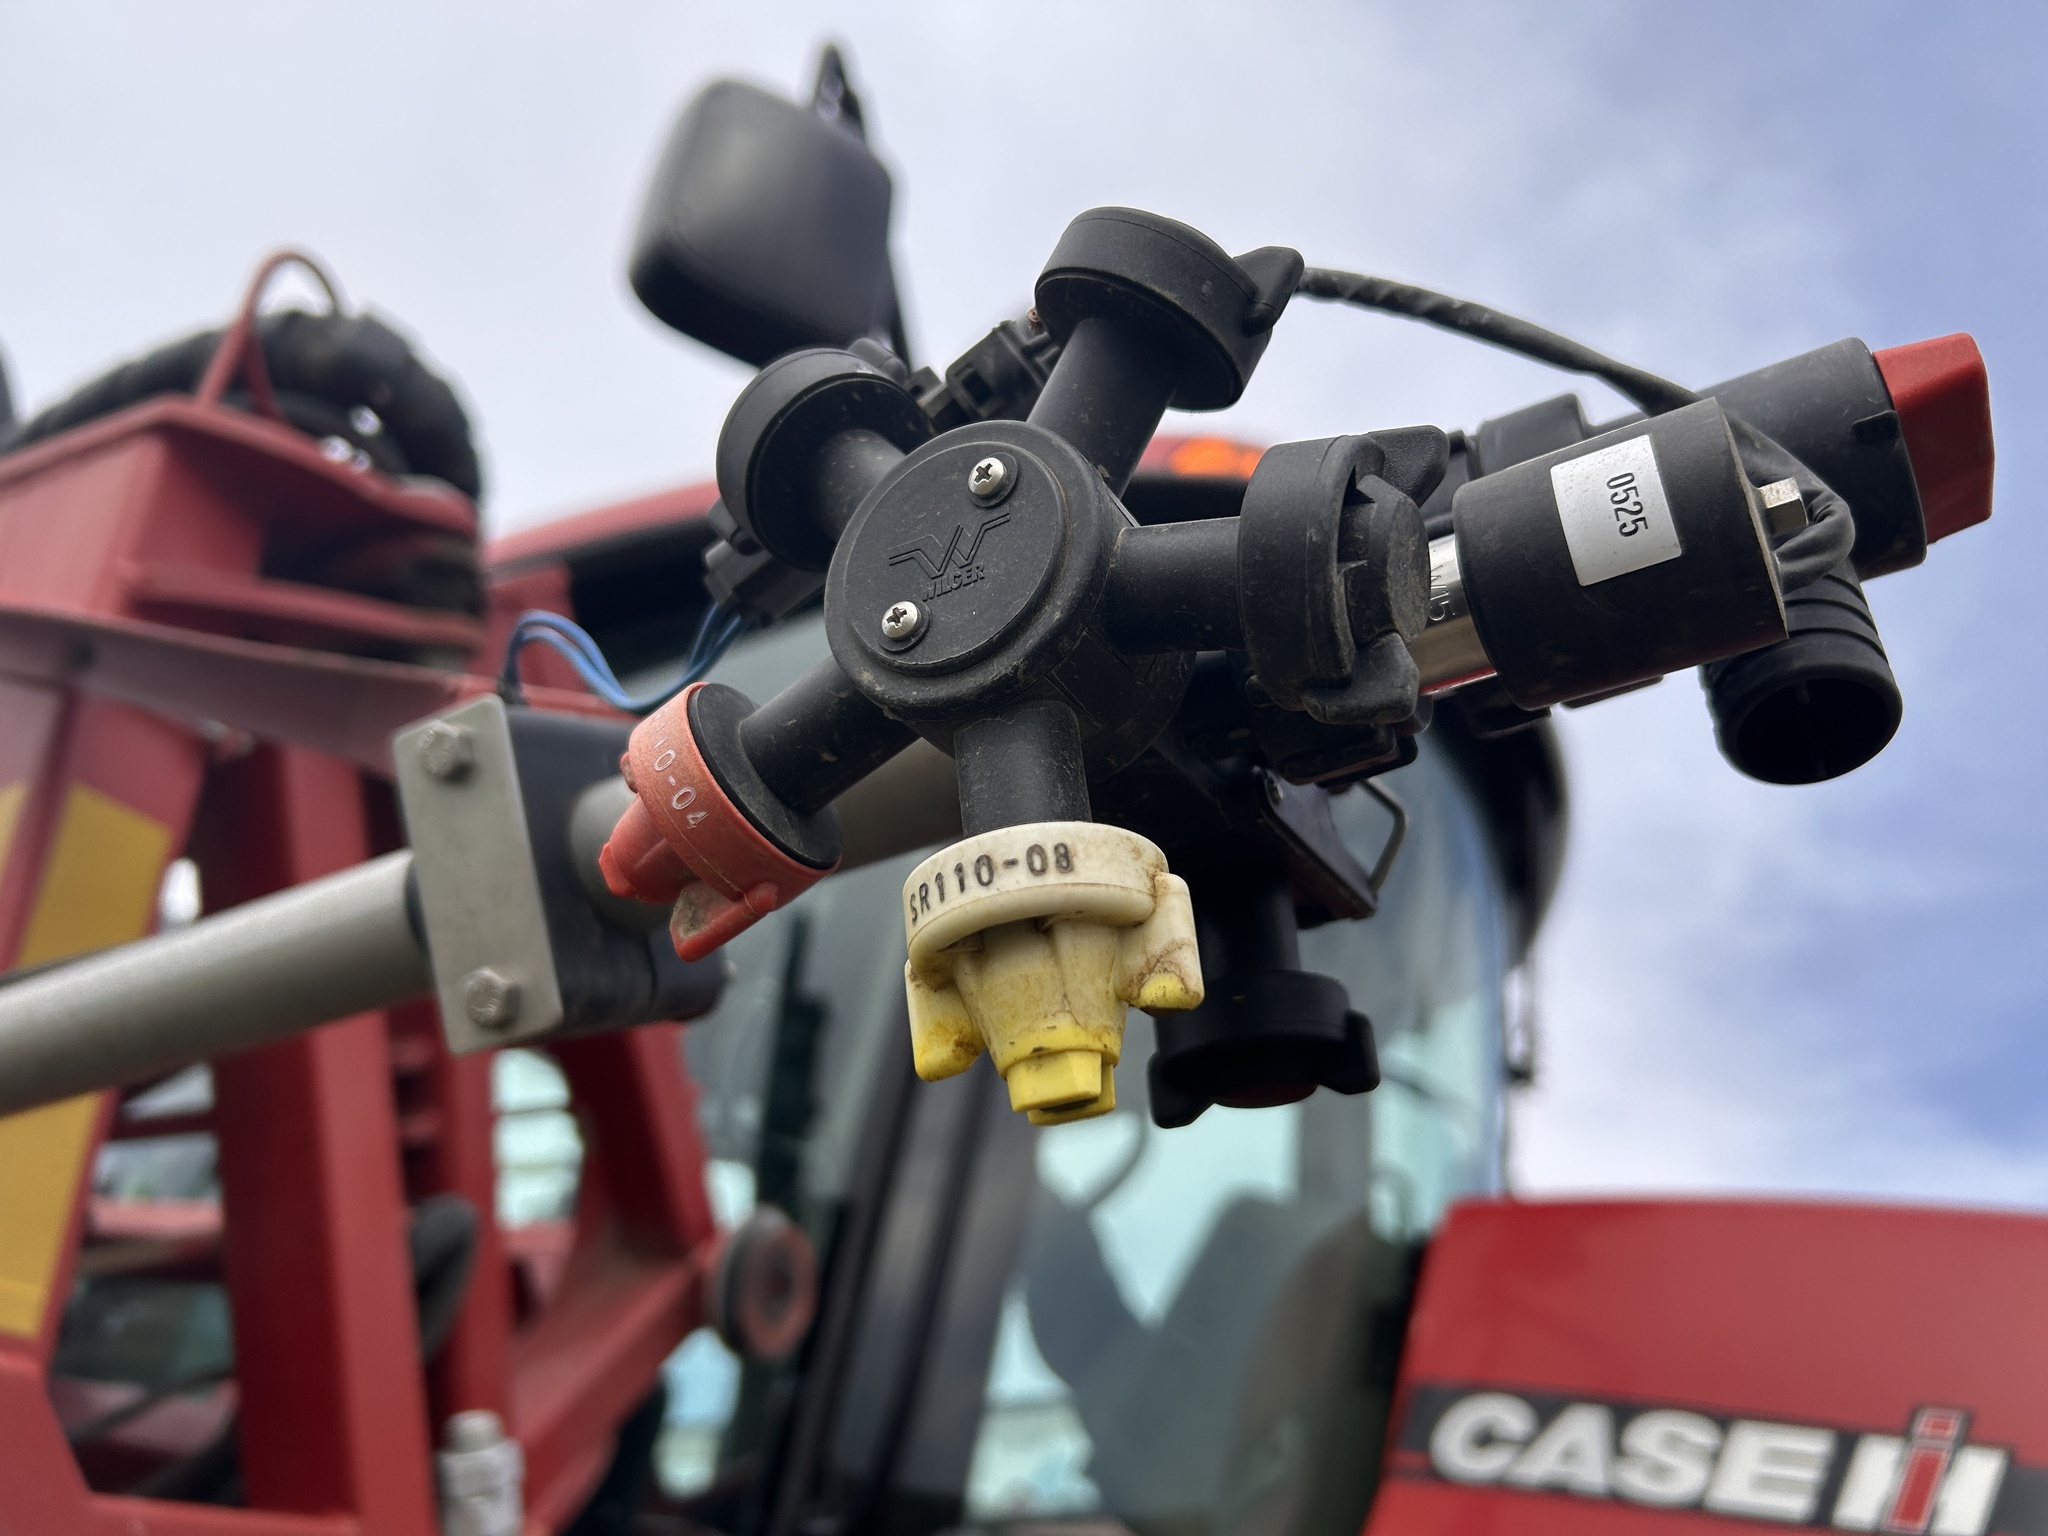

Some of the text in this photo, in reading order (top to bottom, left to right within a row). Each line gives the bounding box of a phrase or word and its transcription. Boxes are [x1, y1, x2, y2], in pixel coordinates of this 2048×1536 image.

[1605, 471, 1649, 538] 0525
[922, 562, 986, 602] WILGER
[908, 841, 1075, 927] SR110-08
[1429, 1391, 1838, 1524] CASE
